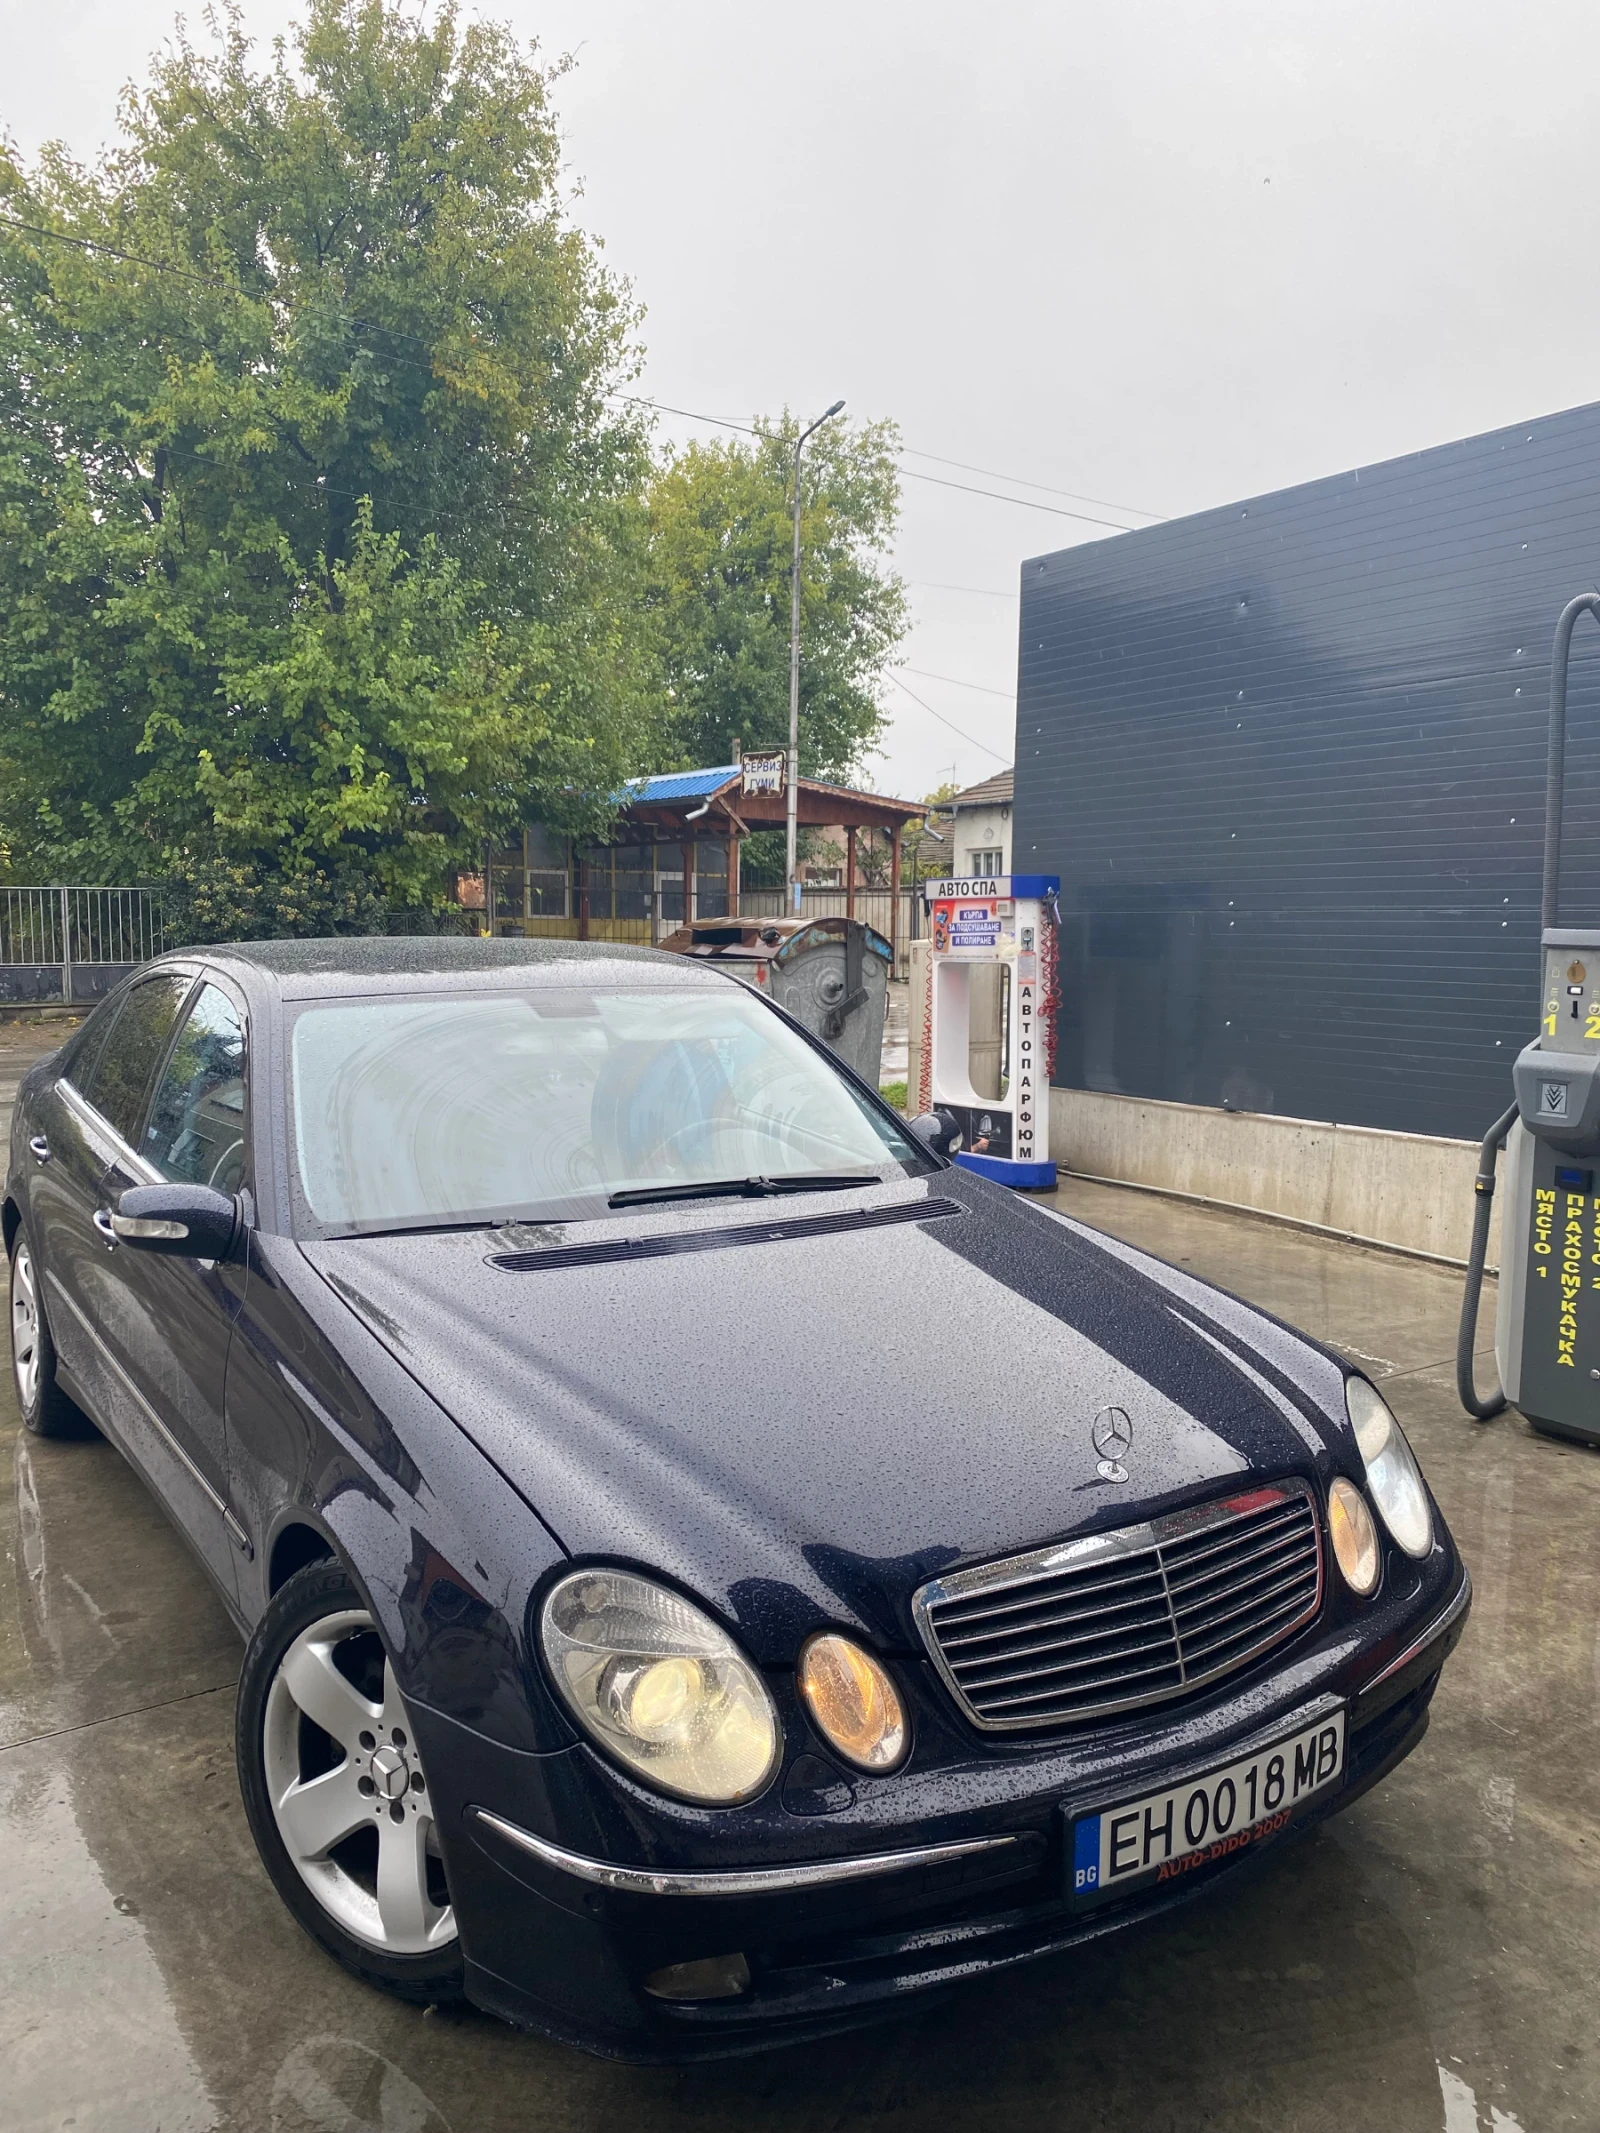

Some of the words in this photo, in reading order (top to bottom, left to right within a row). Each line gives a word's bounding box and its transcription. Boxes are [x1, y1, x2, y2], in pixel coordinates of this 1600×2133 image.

[744, 760, 782, 774] СЕРВИЗ
[750, 778, 775, 790] ГУМИ
[938, 881, 970, 897] АВТО
[971, 880, 997, 896] СПА
[963, 911, 984, 920] КЪРПА
[948, 923, 956, 932] ЗА
[956, 922, 1000, 932] ПОДСУШАВАНЕ
[955, 936, 960, 945] И
[960, 936, 992, 945] ПОЛИРАНЕ
[1543, 1013, 1557, 1036] 1
[1584, 1015, 1600, 1039] 2
[1018, 986, 1034, 1159] АВТОПАРФЮМ
[1533, 1188, 1556, 1255] МЯСТО
[1536, 1265, 1547, 1278] 1
[1557, 1193, 1585, 1367] ПРАХОСМУКАЧКА
[1157, 1829, 1251, 1882] AUTO-DIDO
[1253, 1809, 1292, 1840] 2007
[1075, 1865, 1097, 1888] BG
